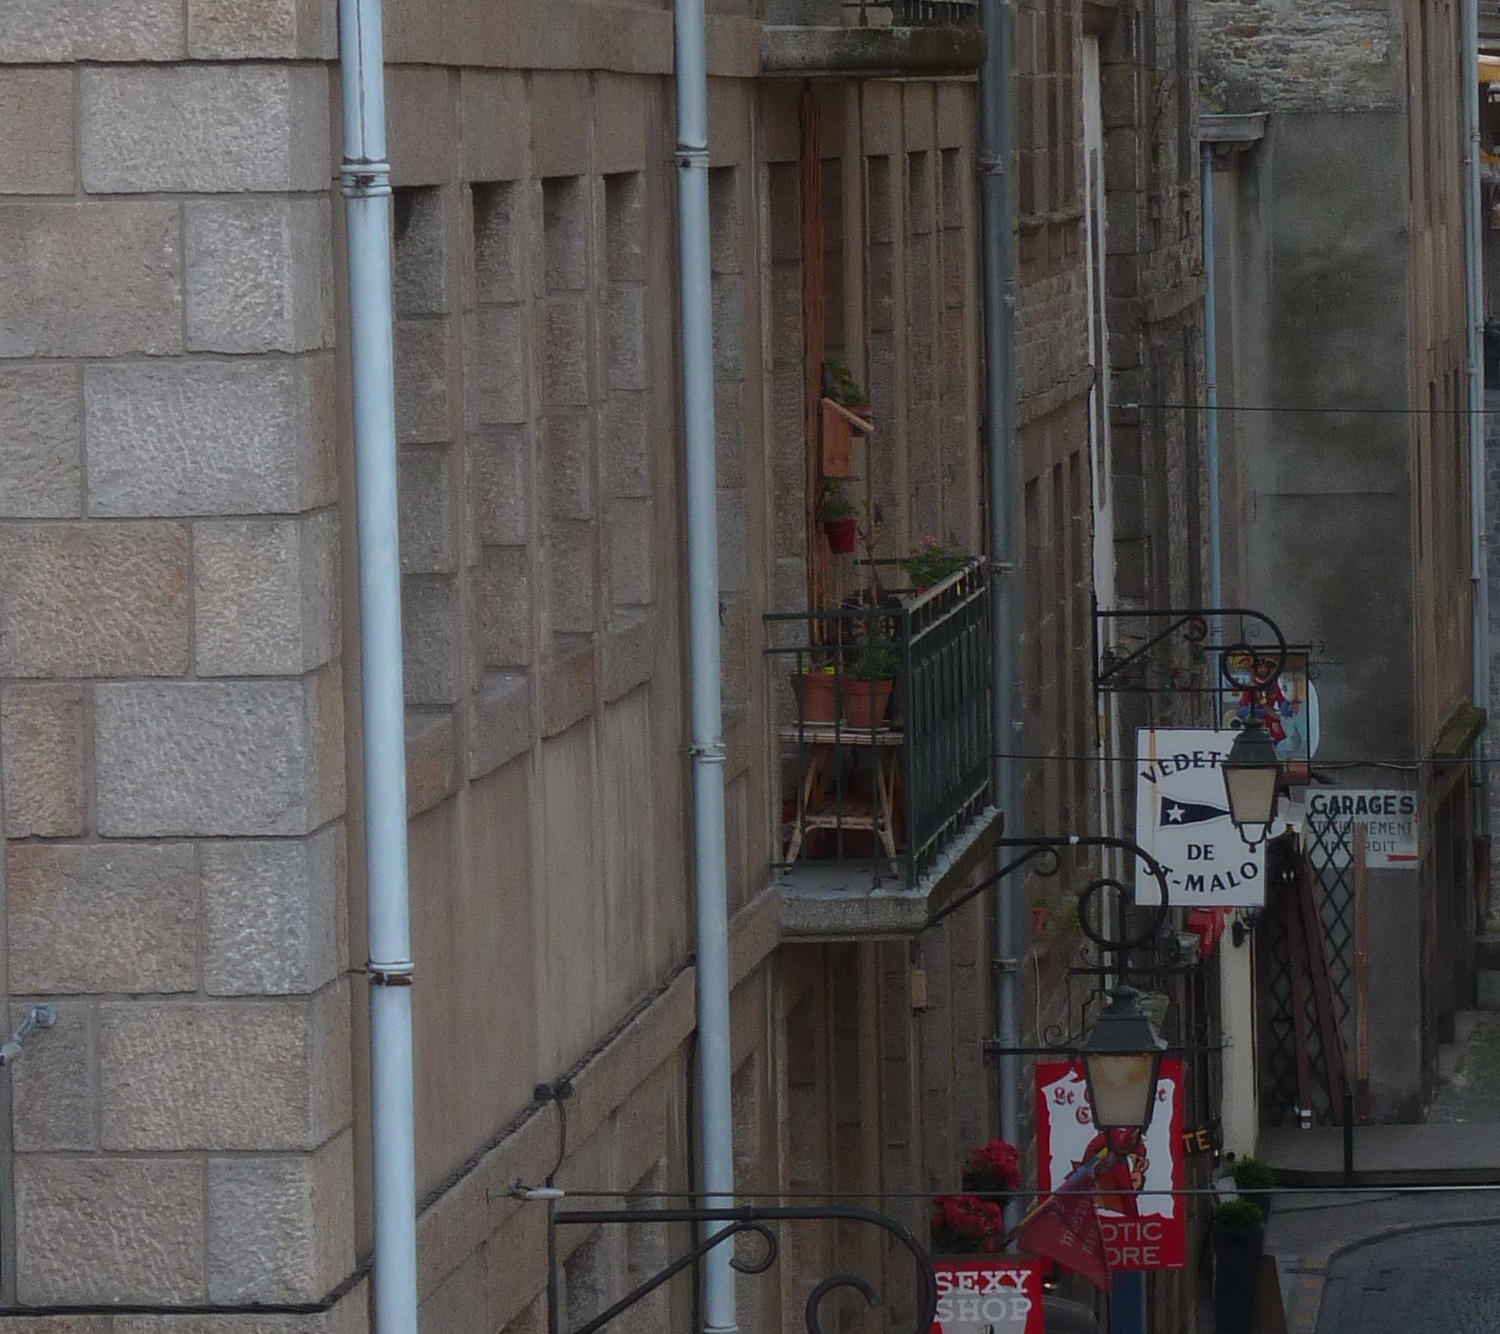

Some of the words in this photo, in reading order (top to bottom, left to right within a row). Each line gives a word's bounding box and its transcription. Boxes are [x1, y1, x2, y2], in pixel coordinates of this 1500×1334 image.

[1140, 750, 1231, 784] VEDET
[1310, 794, 1414, 815] GARAGES
[1309, 821, 1413, 836] STATIOEMENT
[1187, 843, 1214, 861] DE
[1325, 840, 1397, 853] INTRDIT
[1052, 1087, 1076, 1106] Le
[1182, 1125, 1211, 1154] TÉ
[1101, 1222, 1163, 1242] OTIC
[1107, 1246, 1161, 1265] ORE
[934, 1269, 1032, 1296] SEXY
[933, 1296, 1032, 1323] SHOP
